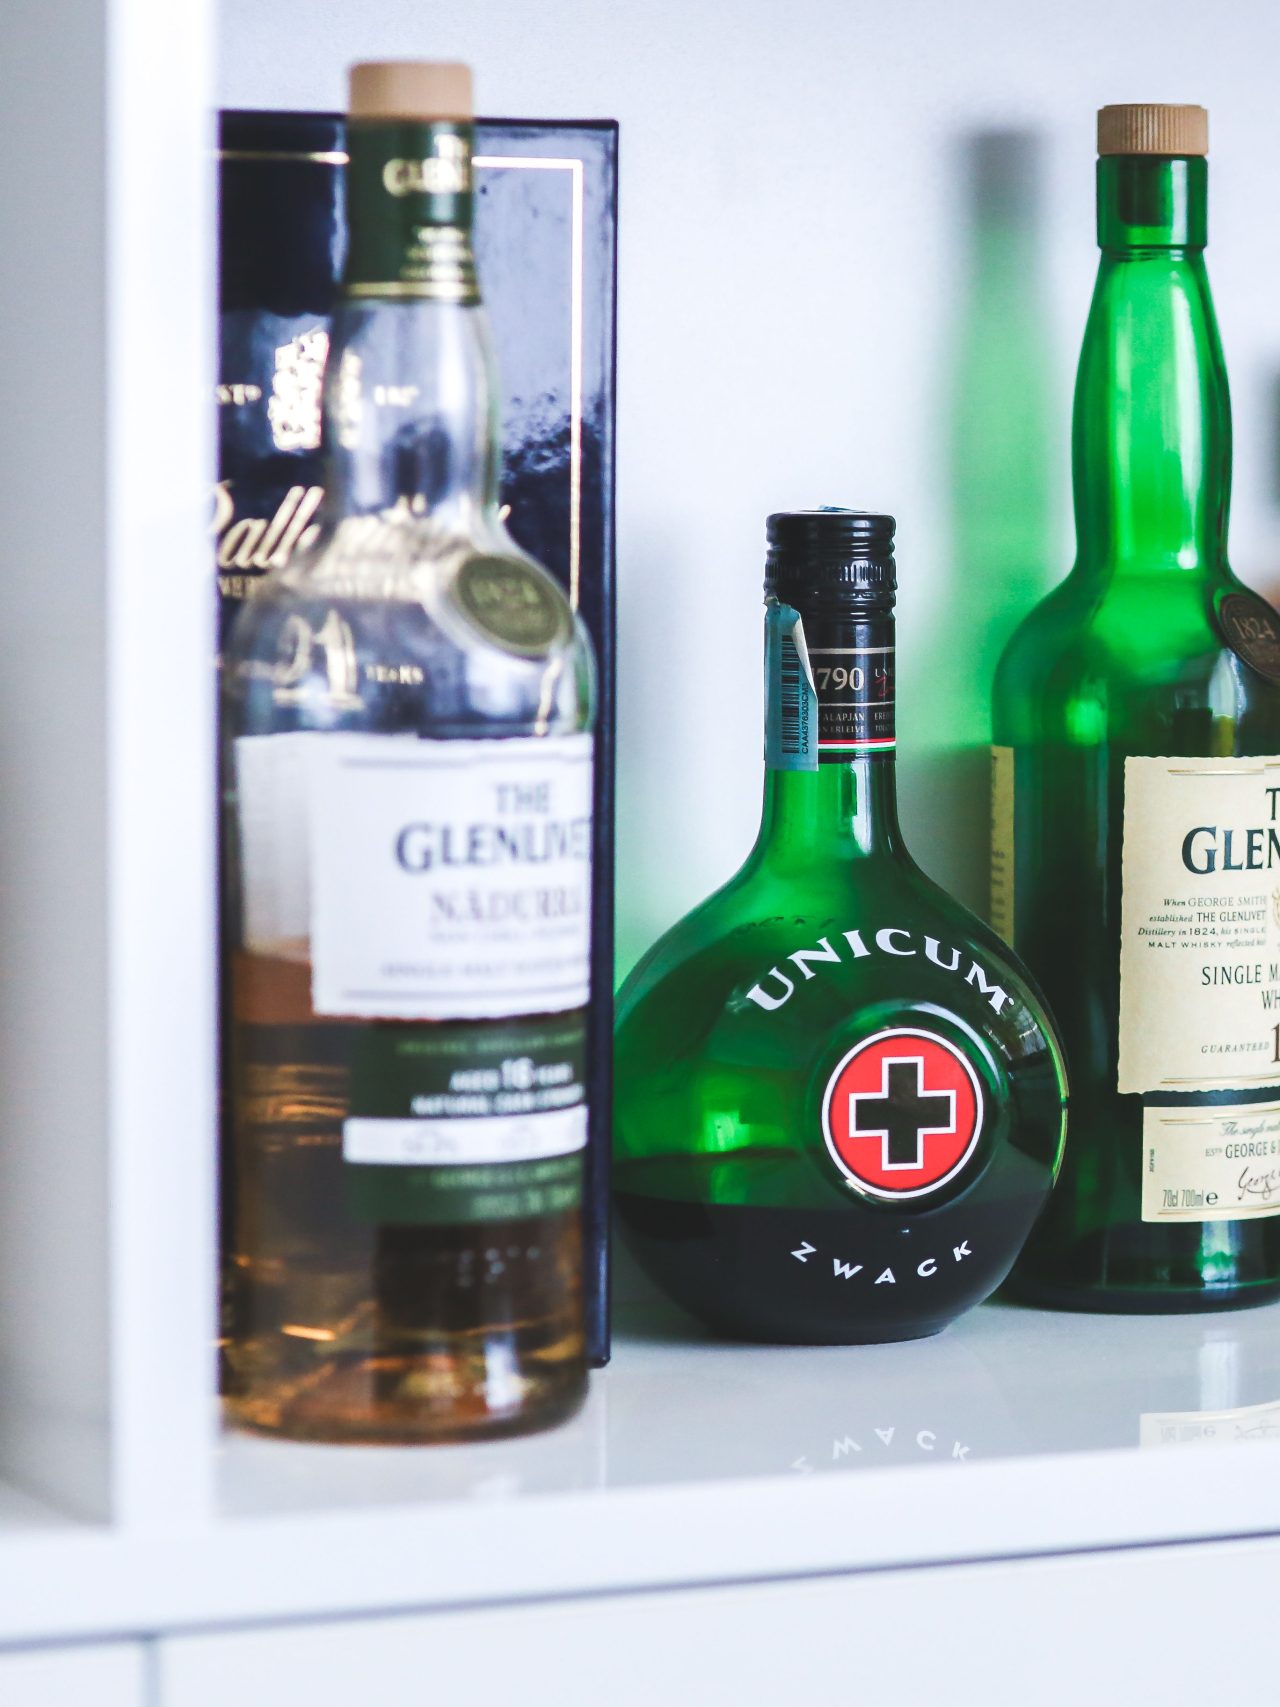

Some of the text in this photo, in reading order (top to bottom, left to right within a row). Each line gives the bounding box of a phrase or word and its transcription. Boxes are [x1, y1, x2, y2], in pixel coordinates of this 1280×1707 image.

[812, 667, 864, 691] 790
[496, 781, 550, 815] THE
[1163, 896, 1267, 907] When GEORGE SMITH
[1149, 910, 1266, 922] established THE GLENLIVET
[1137, 927, 1176, 937] Distillery
[1179, 928, 1187, 936] in
[746, 928, 1008, 1015] UNICUM
[1201, 964, 1262, 986] SINGLE
[1200, 1041, 1270, 1054] GUARANTEED
[1225, 1141, 1268, 1158] GEORGE
[791, 1240, 972, 1284] ZWACK
